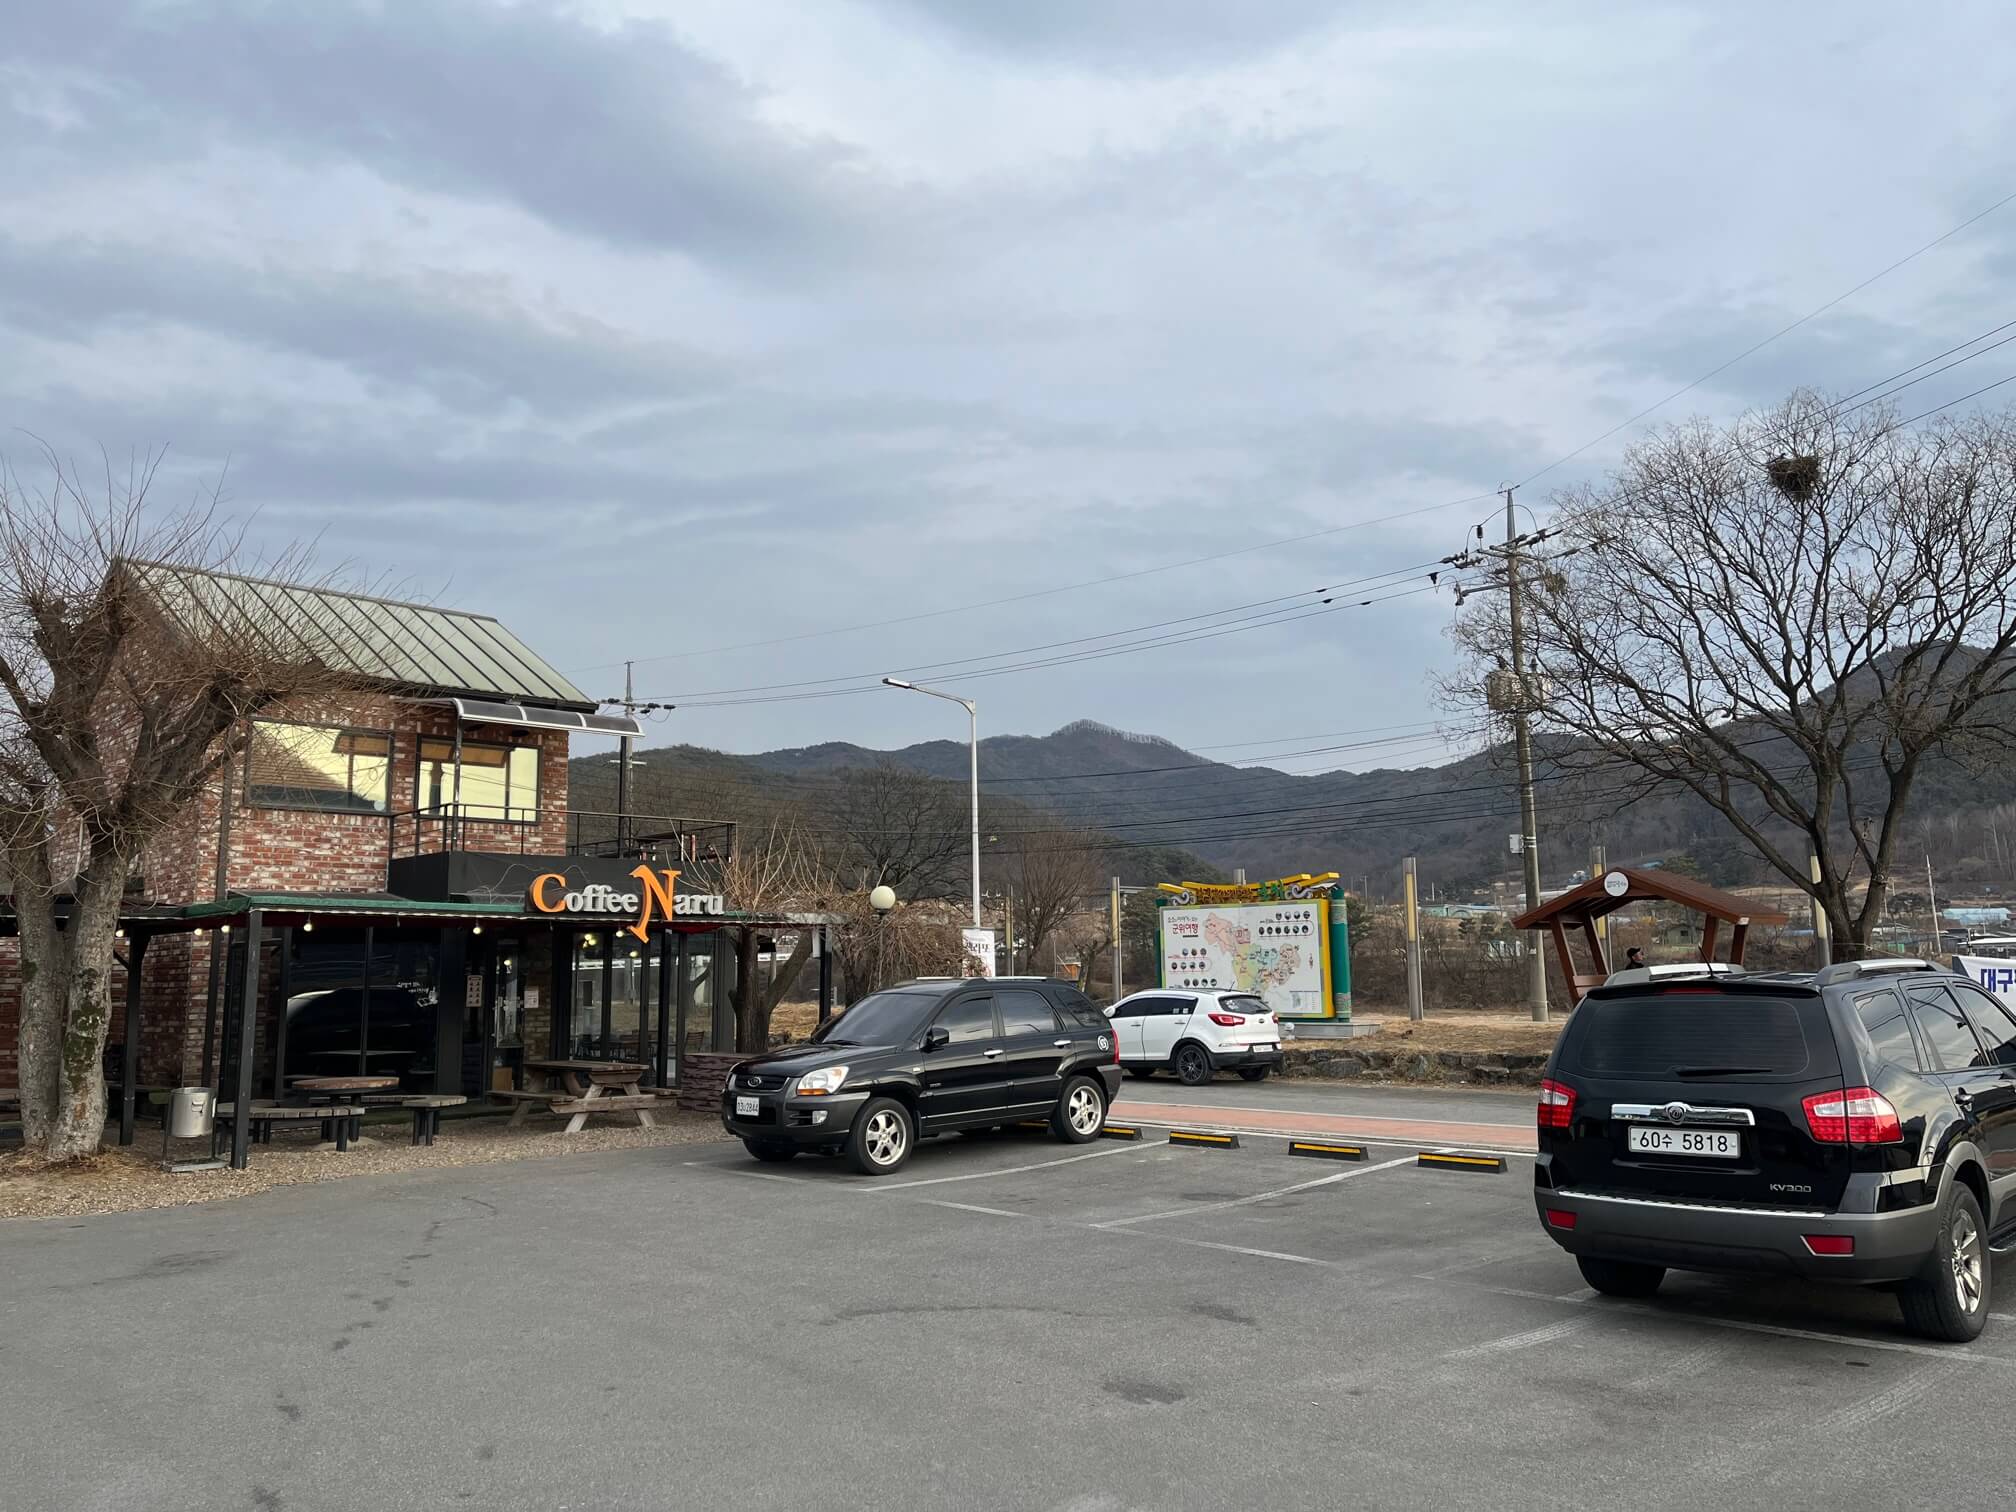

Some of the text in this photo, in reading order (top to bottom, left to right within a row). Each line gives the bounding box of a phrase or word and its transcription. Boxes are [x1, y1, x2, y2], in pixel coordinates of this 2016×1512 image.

[529, 864, 725, 944] Coffee Naru
[1173, 923, 1199, 935] 군위여행
[1980, 968, 2016, 993] 대구
[1639, 1131, 1729, 1153] 60수 5818
[1769, 1183, 1812, 1193] KV300
